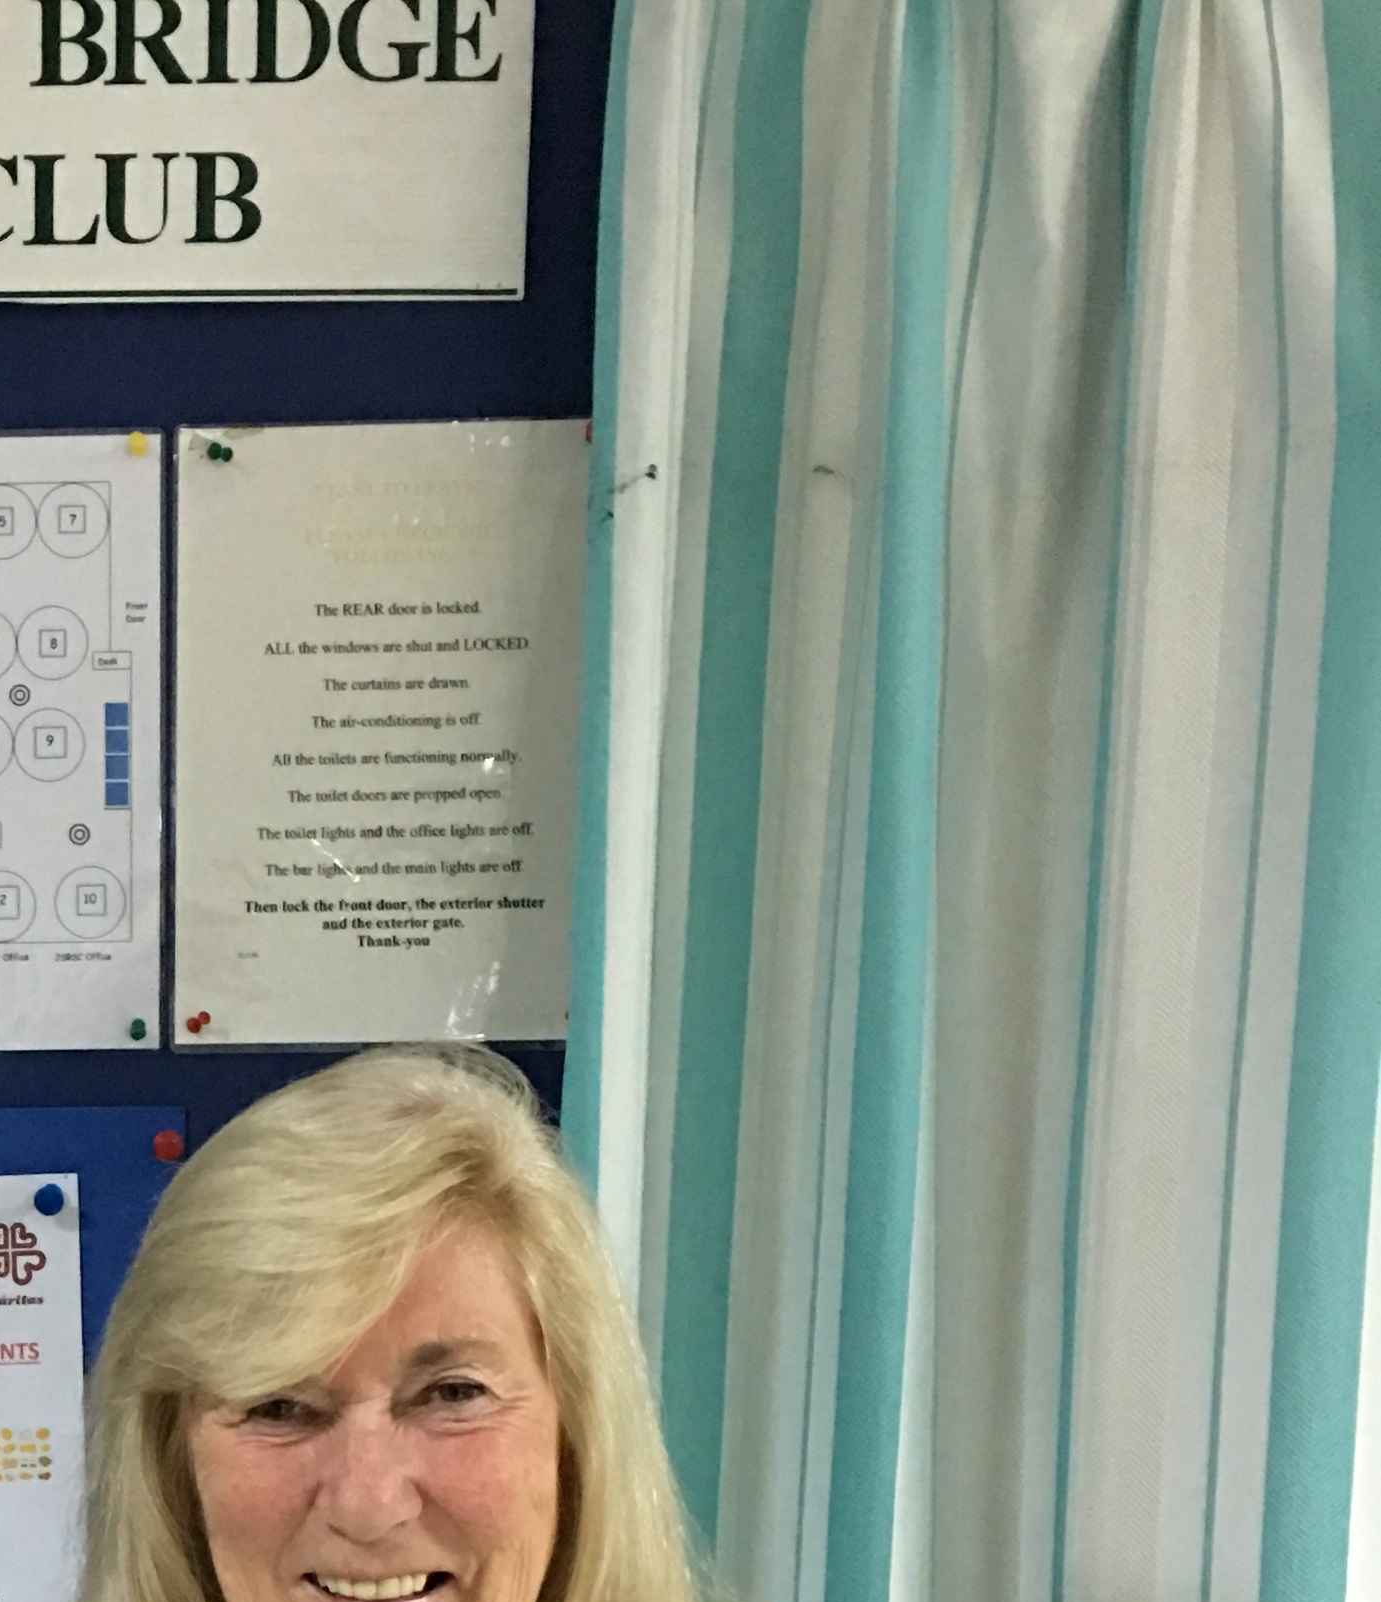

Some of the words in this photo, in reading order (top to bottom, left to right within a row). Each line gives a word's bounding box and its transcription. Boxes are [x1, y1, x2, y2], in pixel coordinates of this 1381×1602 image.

[32, 0, 503, 86] BRIDGE
[69, 514, 76, 524] 7
[314, 604, 338, 616] The
[342, 603, 384, 616] REAR
[388, 603, 417, 615] door
[421, 605, 432, 614] is
[50, 637, 57, 649] 8
[264, 642, 294, 655] ALL
[298, 641, 318, 654] the
[321, 641, 379, 653] windows
[382, 643, 402, 652] are
[406, 639, 432, 652] shut
[436, 638, 459, 651] and
[323, 678, 347, 691] The
[351, 678, 401, 690] curtains
[404, 680, 425, 689] are
[312, 715, 335, 728] The
[339, 714, 442, 730] air-conditioning
[445, 717, 456, 725] is
[46, 734, 54, 746] 9
[273, 754, 290, 765] All
[295, 753, 314, 765] the
[318, 752, 356, 765] toilets
[360, 755, 380, 764] are
[384, 751, 456, 766] functioning
[84, 892, 96, 904] 10
[244, 900, 277, 912] Then
[282, 900, 309, 912] lock
[314, 899, 334, 912] the
[338, 898, 372, 911] front
[415, 898, 436, 910] the
[439, 897, 492, 910] exterior
[497, 896, 544, 908] shutter
[322, 918, 347, 930] and
[351, 917, 372, 929] the
[376, 917, 428, 929] exterior
